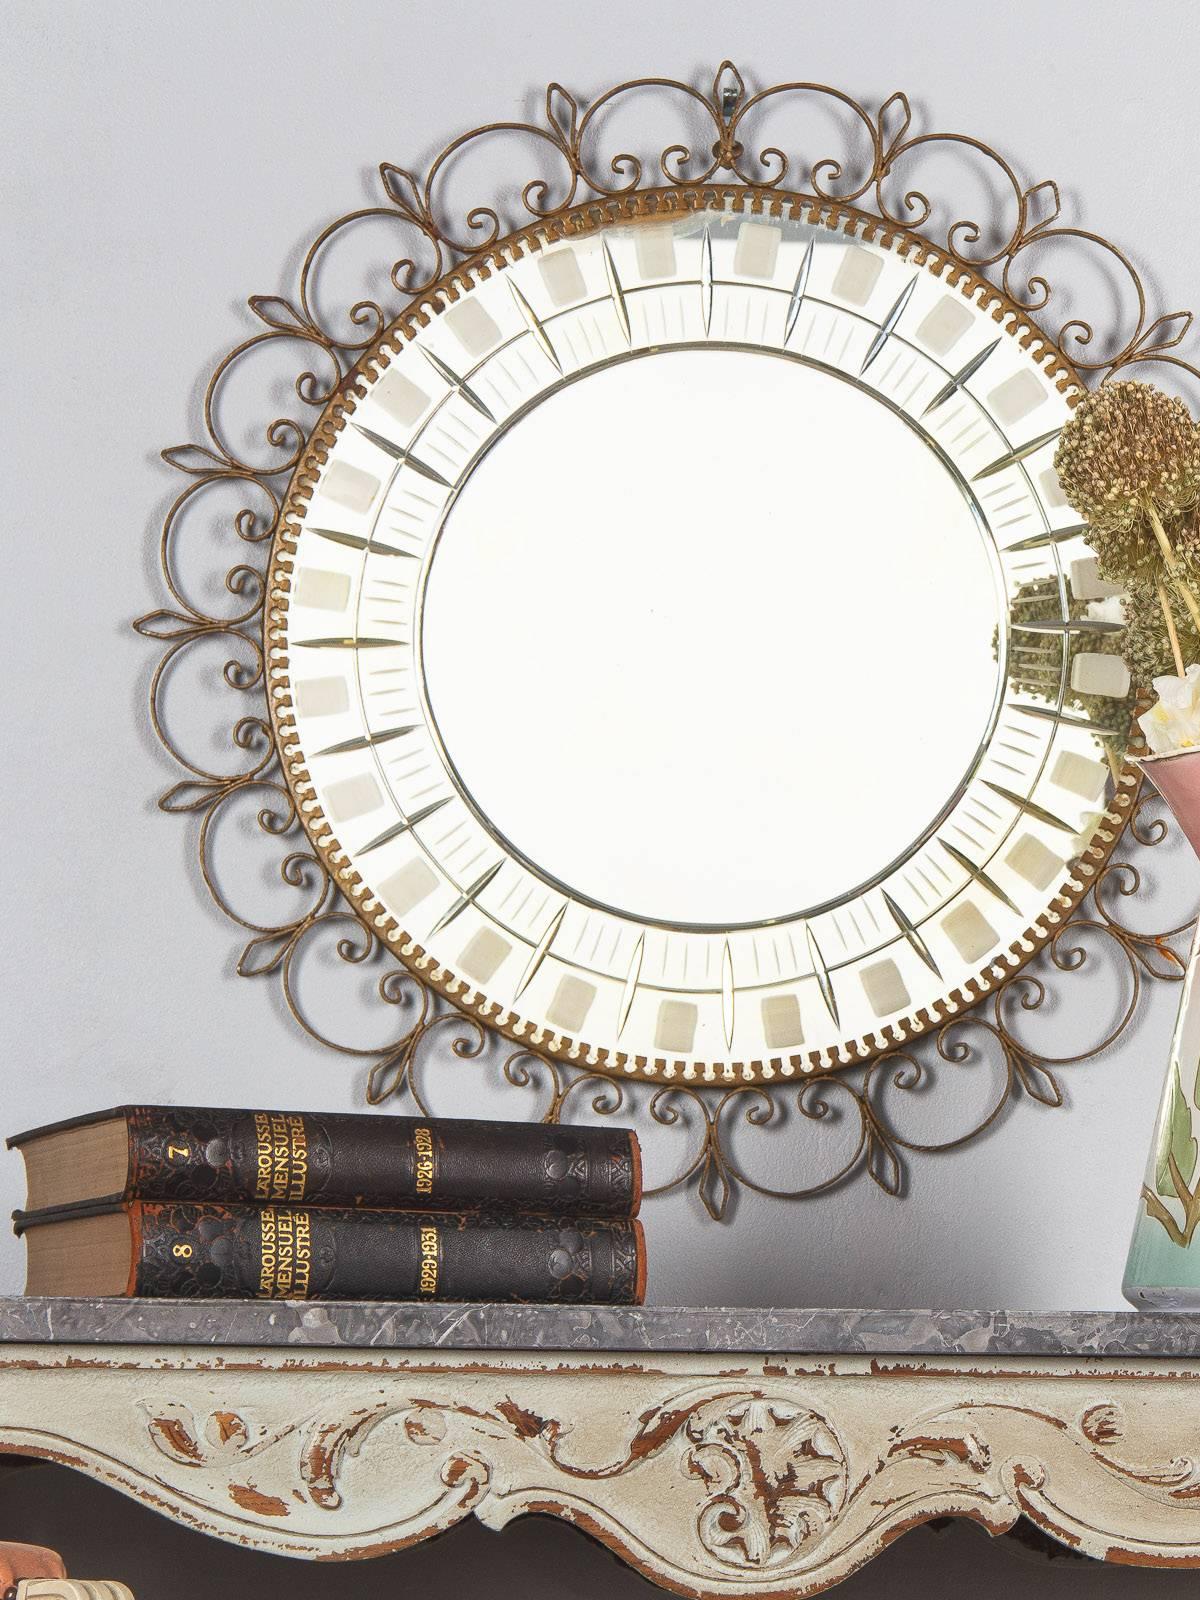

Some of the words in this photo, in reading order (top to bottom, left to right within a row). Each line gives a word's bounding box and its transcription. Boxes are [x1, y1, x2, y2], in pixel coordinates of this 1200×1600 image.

[169, 1146, 190, 1159] 7
[254, 1112, 271, 1200] LAROUSSE
[272, 1113, 288, 1200] MENSUEL
[288, 1114, 306, 1201] ILLUSTRÉ
[415, 1128, 433, 1194] 1926-1928
[172, 1244, 193, 1259] 8
[256, 1209, 275, 1300] LAROUSSE
[275, 1211, 292, 1300] MENSUEL
[292, 1212, 311, 1300] ILLUSTRÉ
